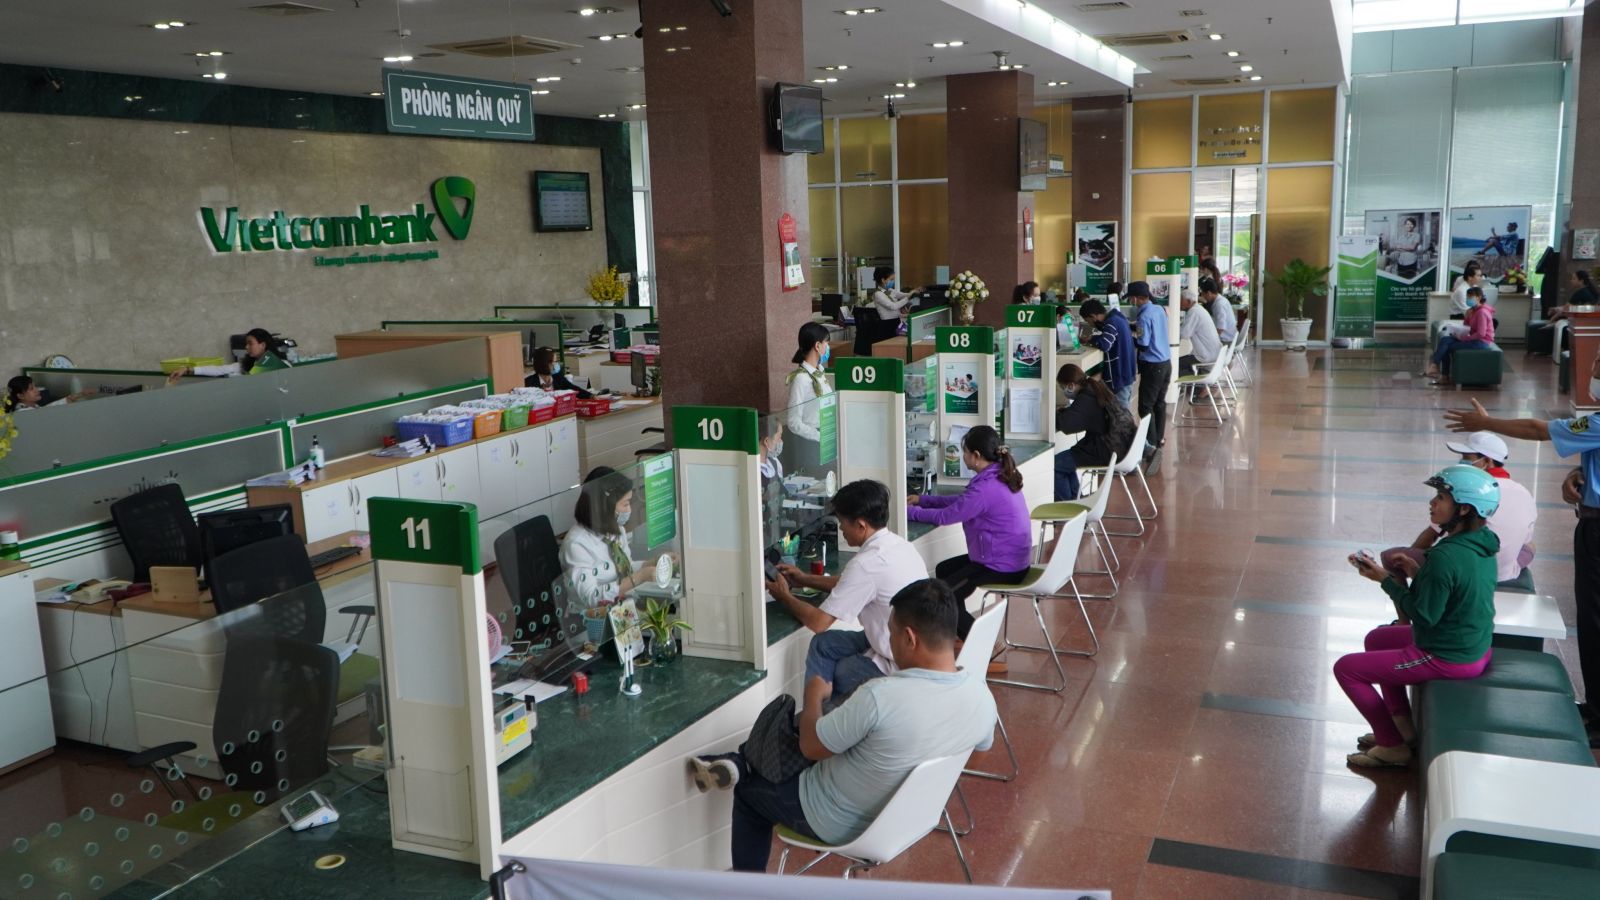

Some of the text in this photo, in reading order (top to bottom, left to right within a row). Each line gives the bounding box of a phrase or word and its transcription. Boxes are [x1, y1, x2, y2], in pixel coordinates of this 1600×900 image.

[400, 82, 522, 127] PHÒNG NGÂN QUỸ
[199, 203, 438, 253] Vietcombank
[1154, 264, 1167, 273] 06
[1017, 310, 1035, 323] 07
[949, 333, 971, 348] 08
[851, 365, 876, 384] 09
[697, 417, 724, 441] 10
[400, 516, 432, 550] 11
